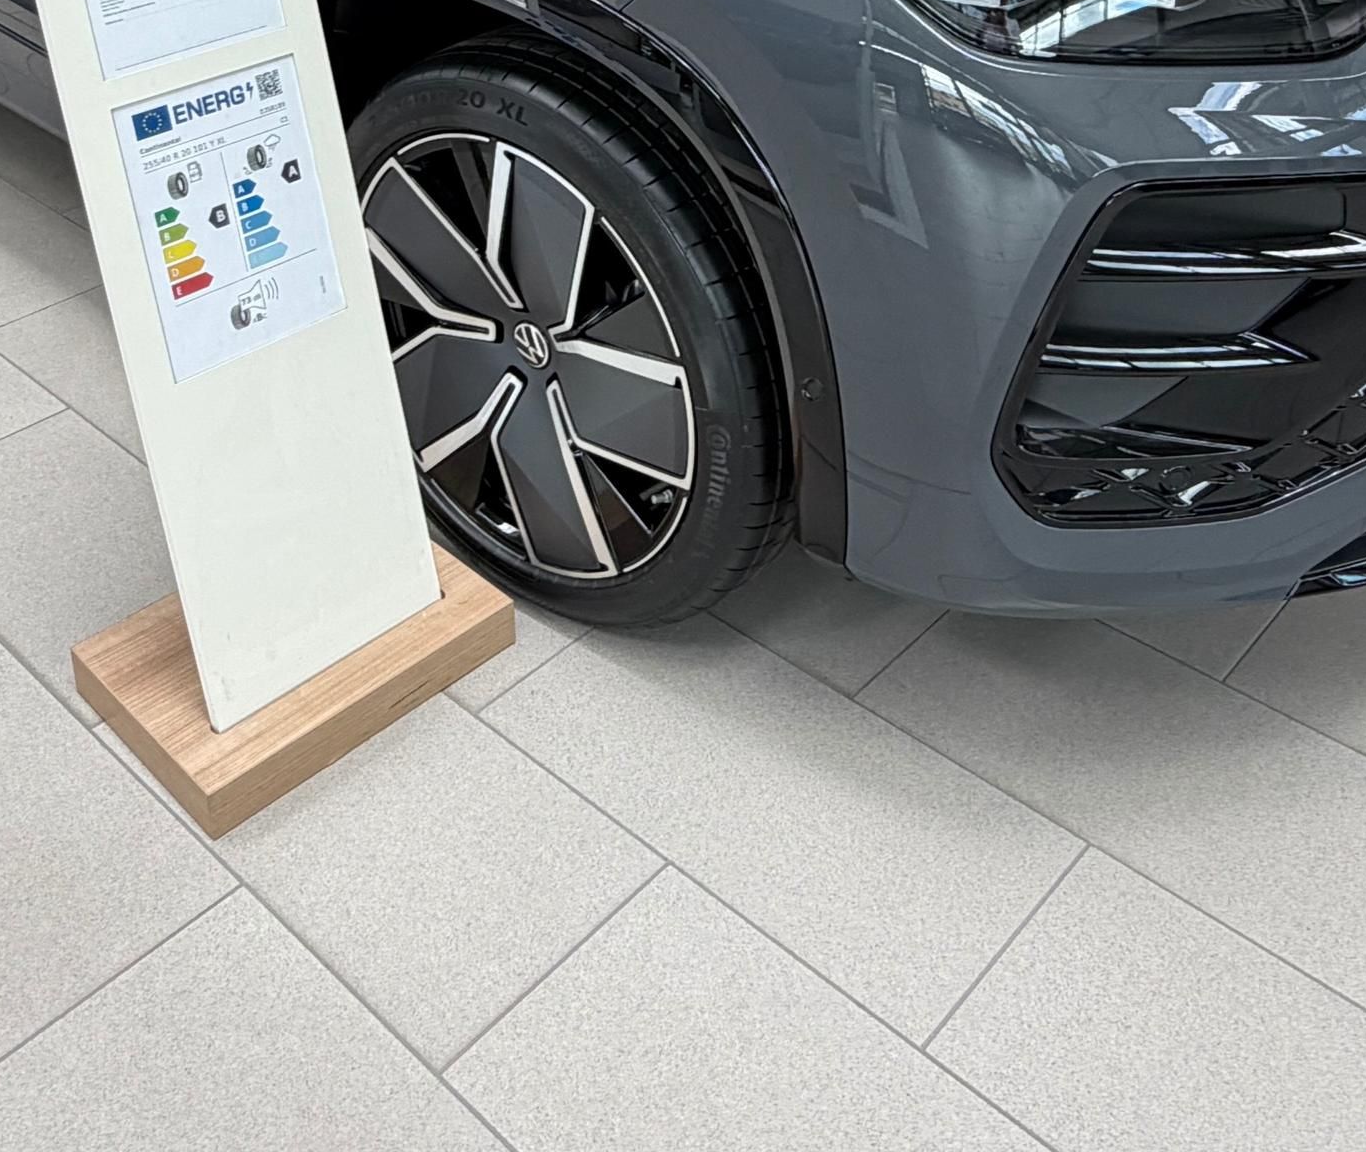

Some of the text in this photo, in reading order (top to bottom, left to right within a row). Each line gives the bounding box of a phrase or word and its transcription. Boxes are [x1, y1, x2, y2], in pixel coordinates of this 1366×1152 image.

[172, 85, 246, 125] ENERG
[496, 98, 529, 127] XL
[288, 166, 298, 178] A
[238, 185, 245, 194] A
[160, 213, 168, 223] A
[215, 210, 226, 223] B
[249, 237, 257, 247] D
[176, 285, 183, 296] E
